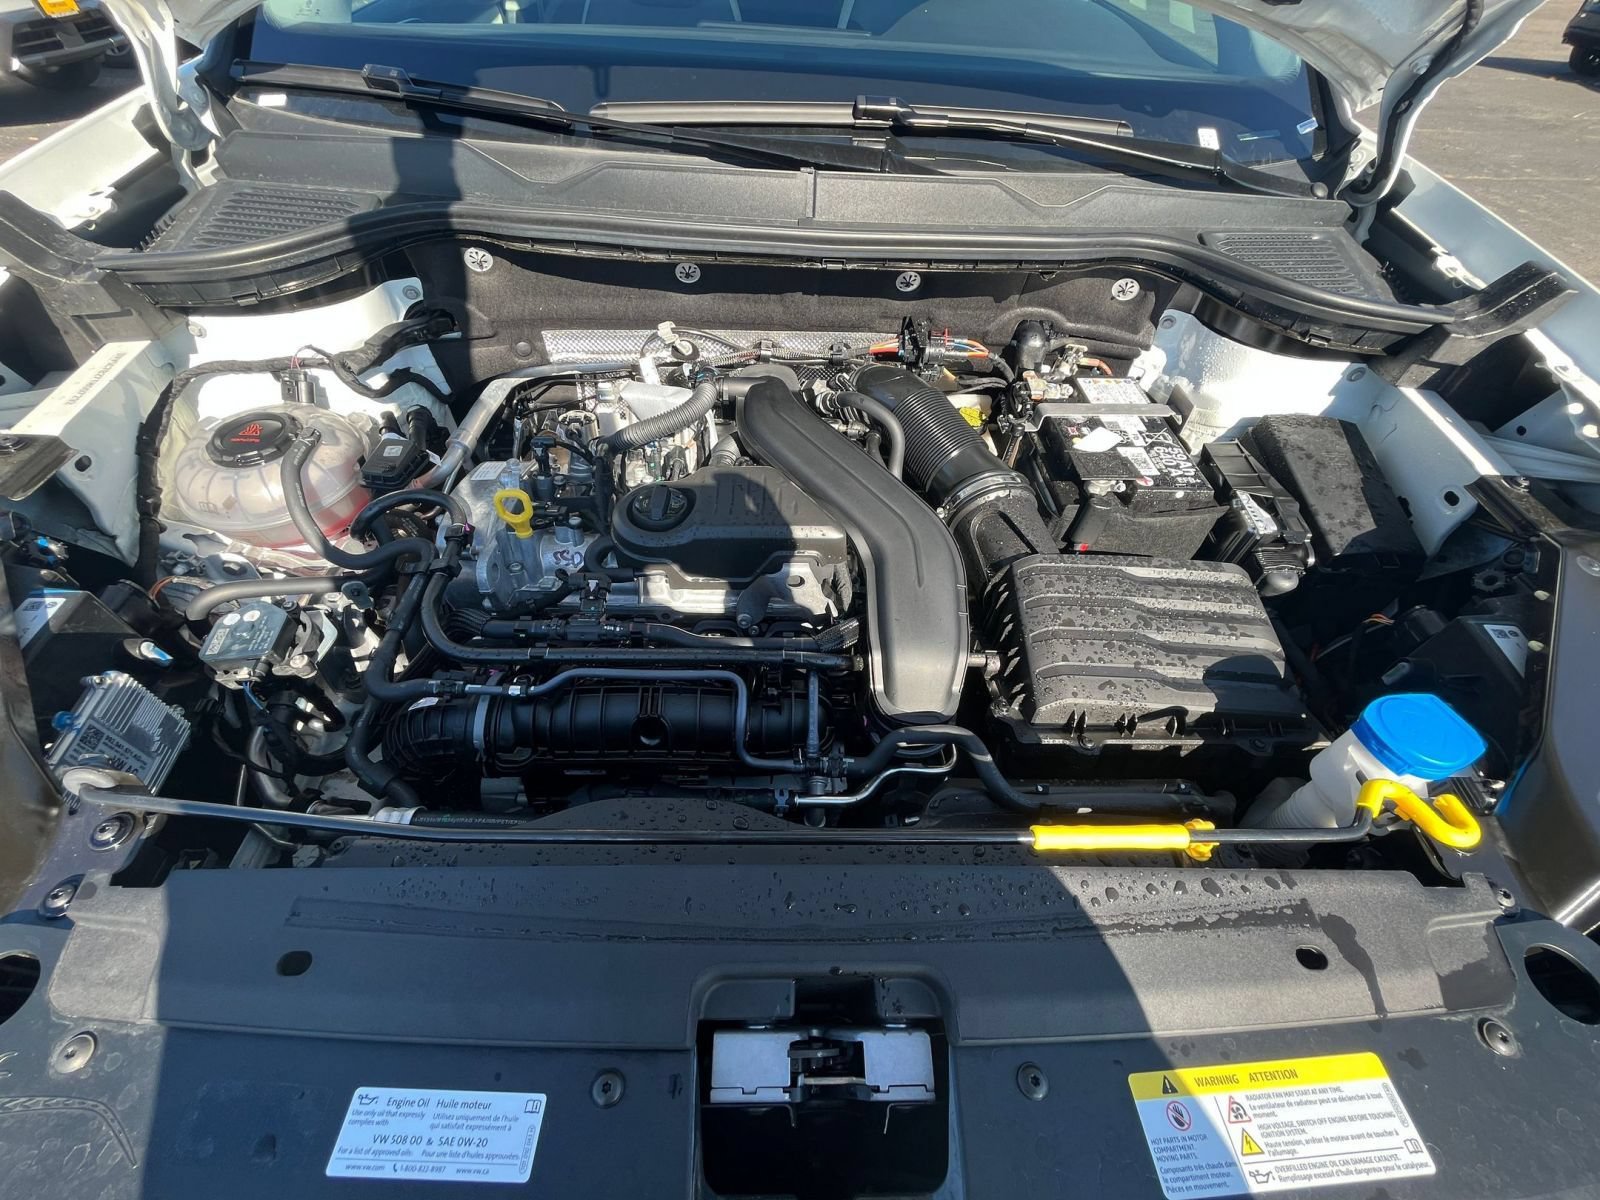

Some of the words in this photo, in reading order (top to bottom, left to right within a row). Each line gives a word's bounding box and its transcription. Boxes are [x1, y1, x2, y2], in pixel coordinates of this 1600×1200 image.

[1153, 447, 1177, 467] 640
[1168, 446, 1197, 477] 59Ah
[1194, 1073, 1240, 1089] WARNING
[1249, 1069, 1298, 1083] ATTENTION
[1245, 1092, 1272, 1101] RADIATOR
[1272, 1091, 1284, 1099] FAN
[1283, 1090, 1296, 1098] MAY
[1295, 1089, 1311, 1097] START
[1319, 1087, 1330, 1095] ANY
[386, 1097, 416, 1110] Engine
[417, 1098, 431, 1108] Oil
[436, 1099, 459, 1109] Huile
[460, 1101, 492, 1110] moteur
[1257, 1101, 1286, 1110] ventilateur
[1293, 1098, 1318, 1107] radiateur
[1319, 1097, 1331, 1106] peut
[363, 1109, 376, 1118] only
[386, 1110, 399, 1118] that
[399, 1111, 426, 1120] expressly
[433, 1112, 455, 1121] Utilisez
[455, 1113, 492, 1123] uniquement
[1257, 1121, 1273, 1130] HIGH
[1296, 1118, 1316, 1127] SWITCH
[1327, 1115, 1348, 1124] ENGINE
[1348, 1113, 1369, 1122] BEFORE
[1368, 1111, 1396, 1121] TOUCHING
[429, 1122, 440, 1131] qui
[441, 1122, 464, 1130] satisfait
[1150, 1138, 1162, 1146] HOT
[1188, 1134, 1208, 1142] MOTOR
[1261, 1130, 1287, 1139] IGNITION
[1264, 1140, 1281, 1149] Haute
[1329, 1134, 1351, 1142] moteur
[1350, 1132, 1366, 1140] avant
[373, 1134, 390, 1145] VW
[391, 1134, 409, 1145] 508
[410, 1135, 423, 1146] 00
[426, 1137, 434, 1146] &
[438, 1136, 456, 1147] SAE
[457, 1137, 489, 1148] 0W-20
[338, 1146, 349, 1154] For
[371, 1147, 401, 1157] approved
[421, 1149, 436, 1158] Pour
[1156, 1154, 1179, 1163] MOVING
[1275, 1163, 1308, 1173] OVERFILLED
[1307, 1161, 1330, 1170] ENGINE
[1338, 1158, 1350, 1167] CAN
[1350, 1156, 1373, 1165] DAMAGE
[1160, 1163, 1192, 1175] Composants
[1169, 1173, 1209, 1183] compartiment
[1185, 1183, 1193, 1191] en
